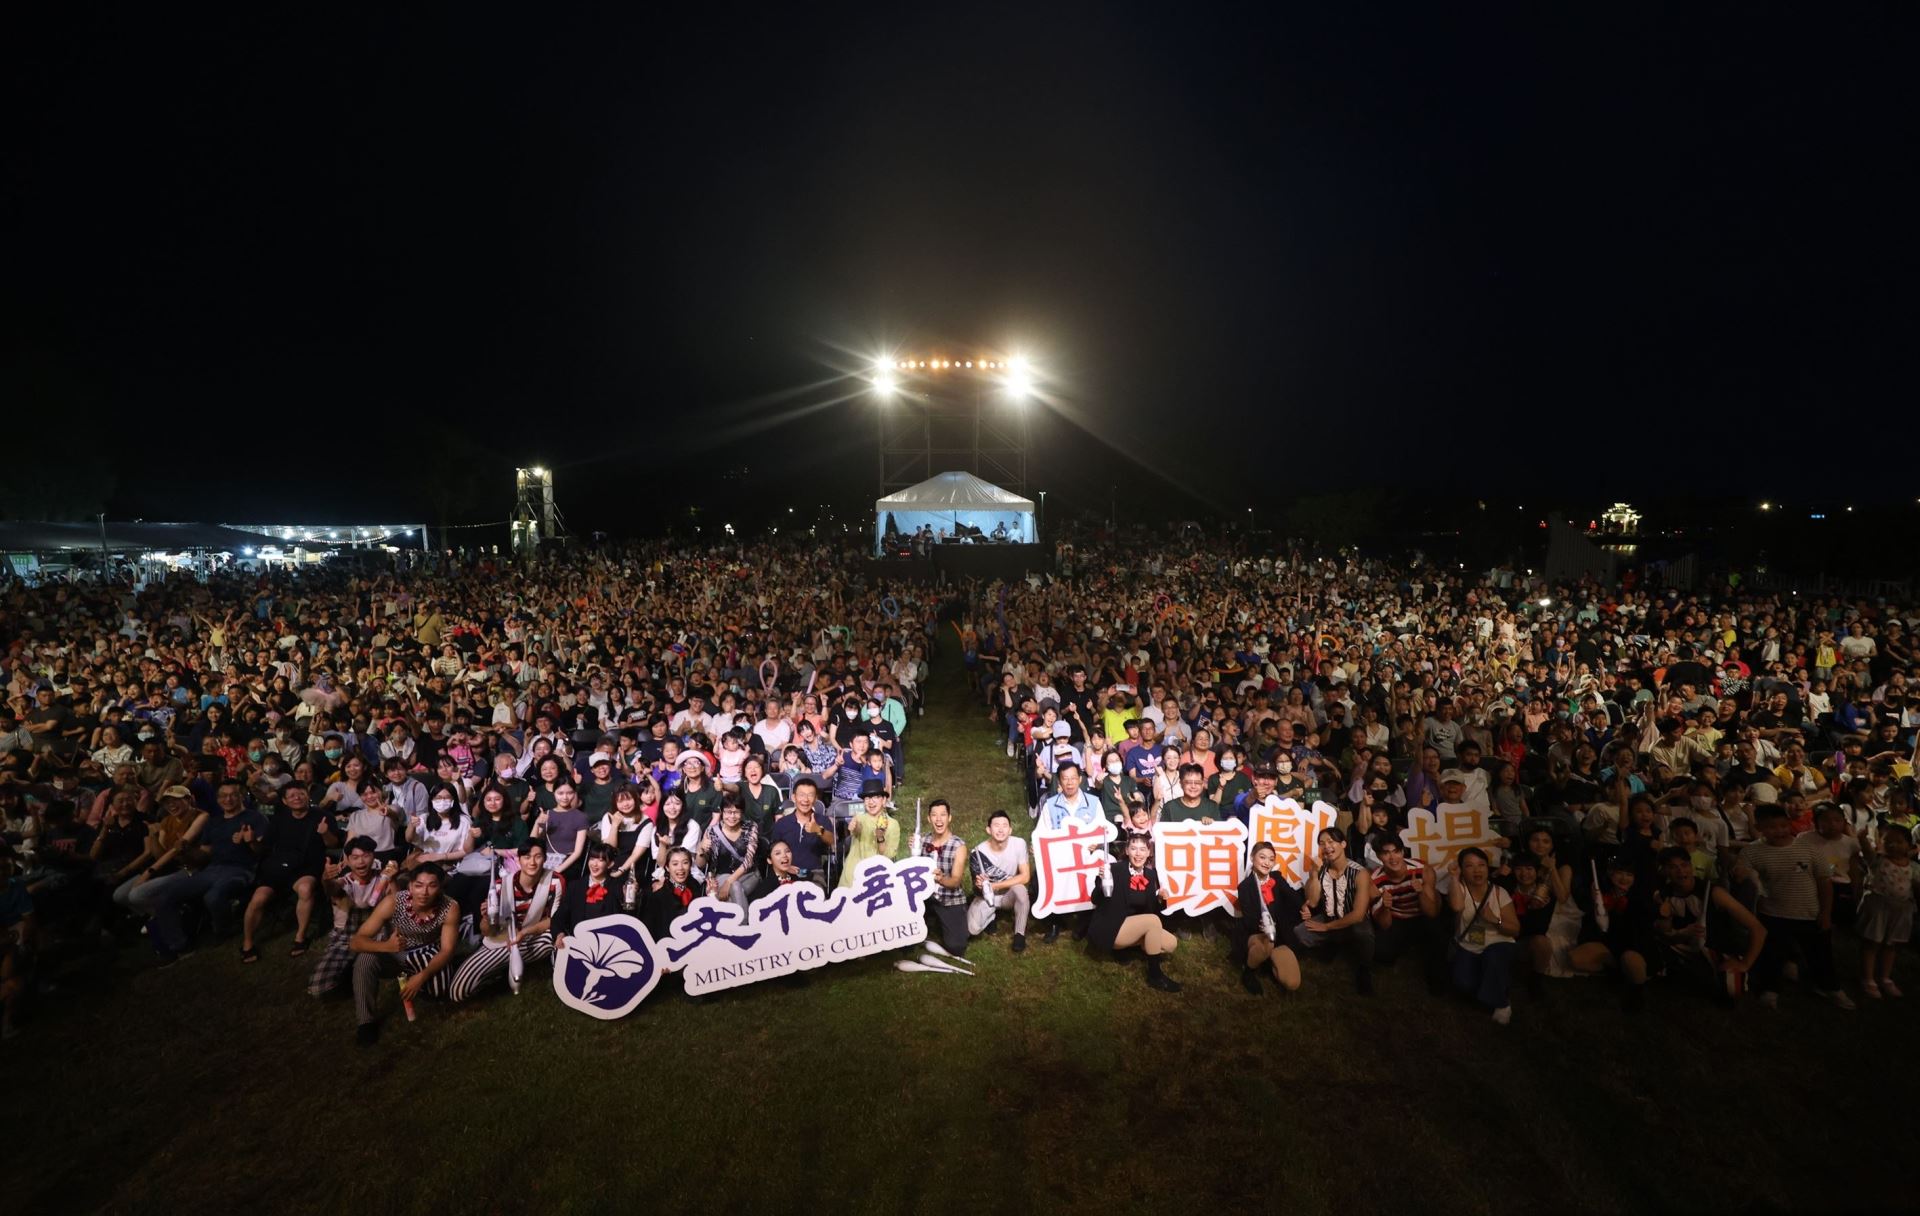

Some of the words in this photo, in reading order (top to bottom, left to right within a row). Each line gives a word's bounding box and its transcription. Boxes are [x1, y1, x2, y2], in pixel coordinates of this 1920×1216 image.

[1039, 824, 1105, 911] 庄
[1162, 827, 1242, 913] 頭
[667, 865, 930, 962] 文化部
[695, 951, 793, 986] MINISTRY
[798, 943, 825, 962] OF
[830, 922, 920, 954] CULTURE
